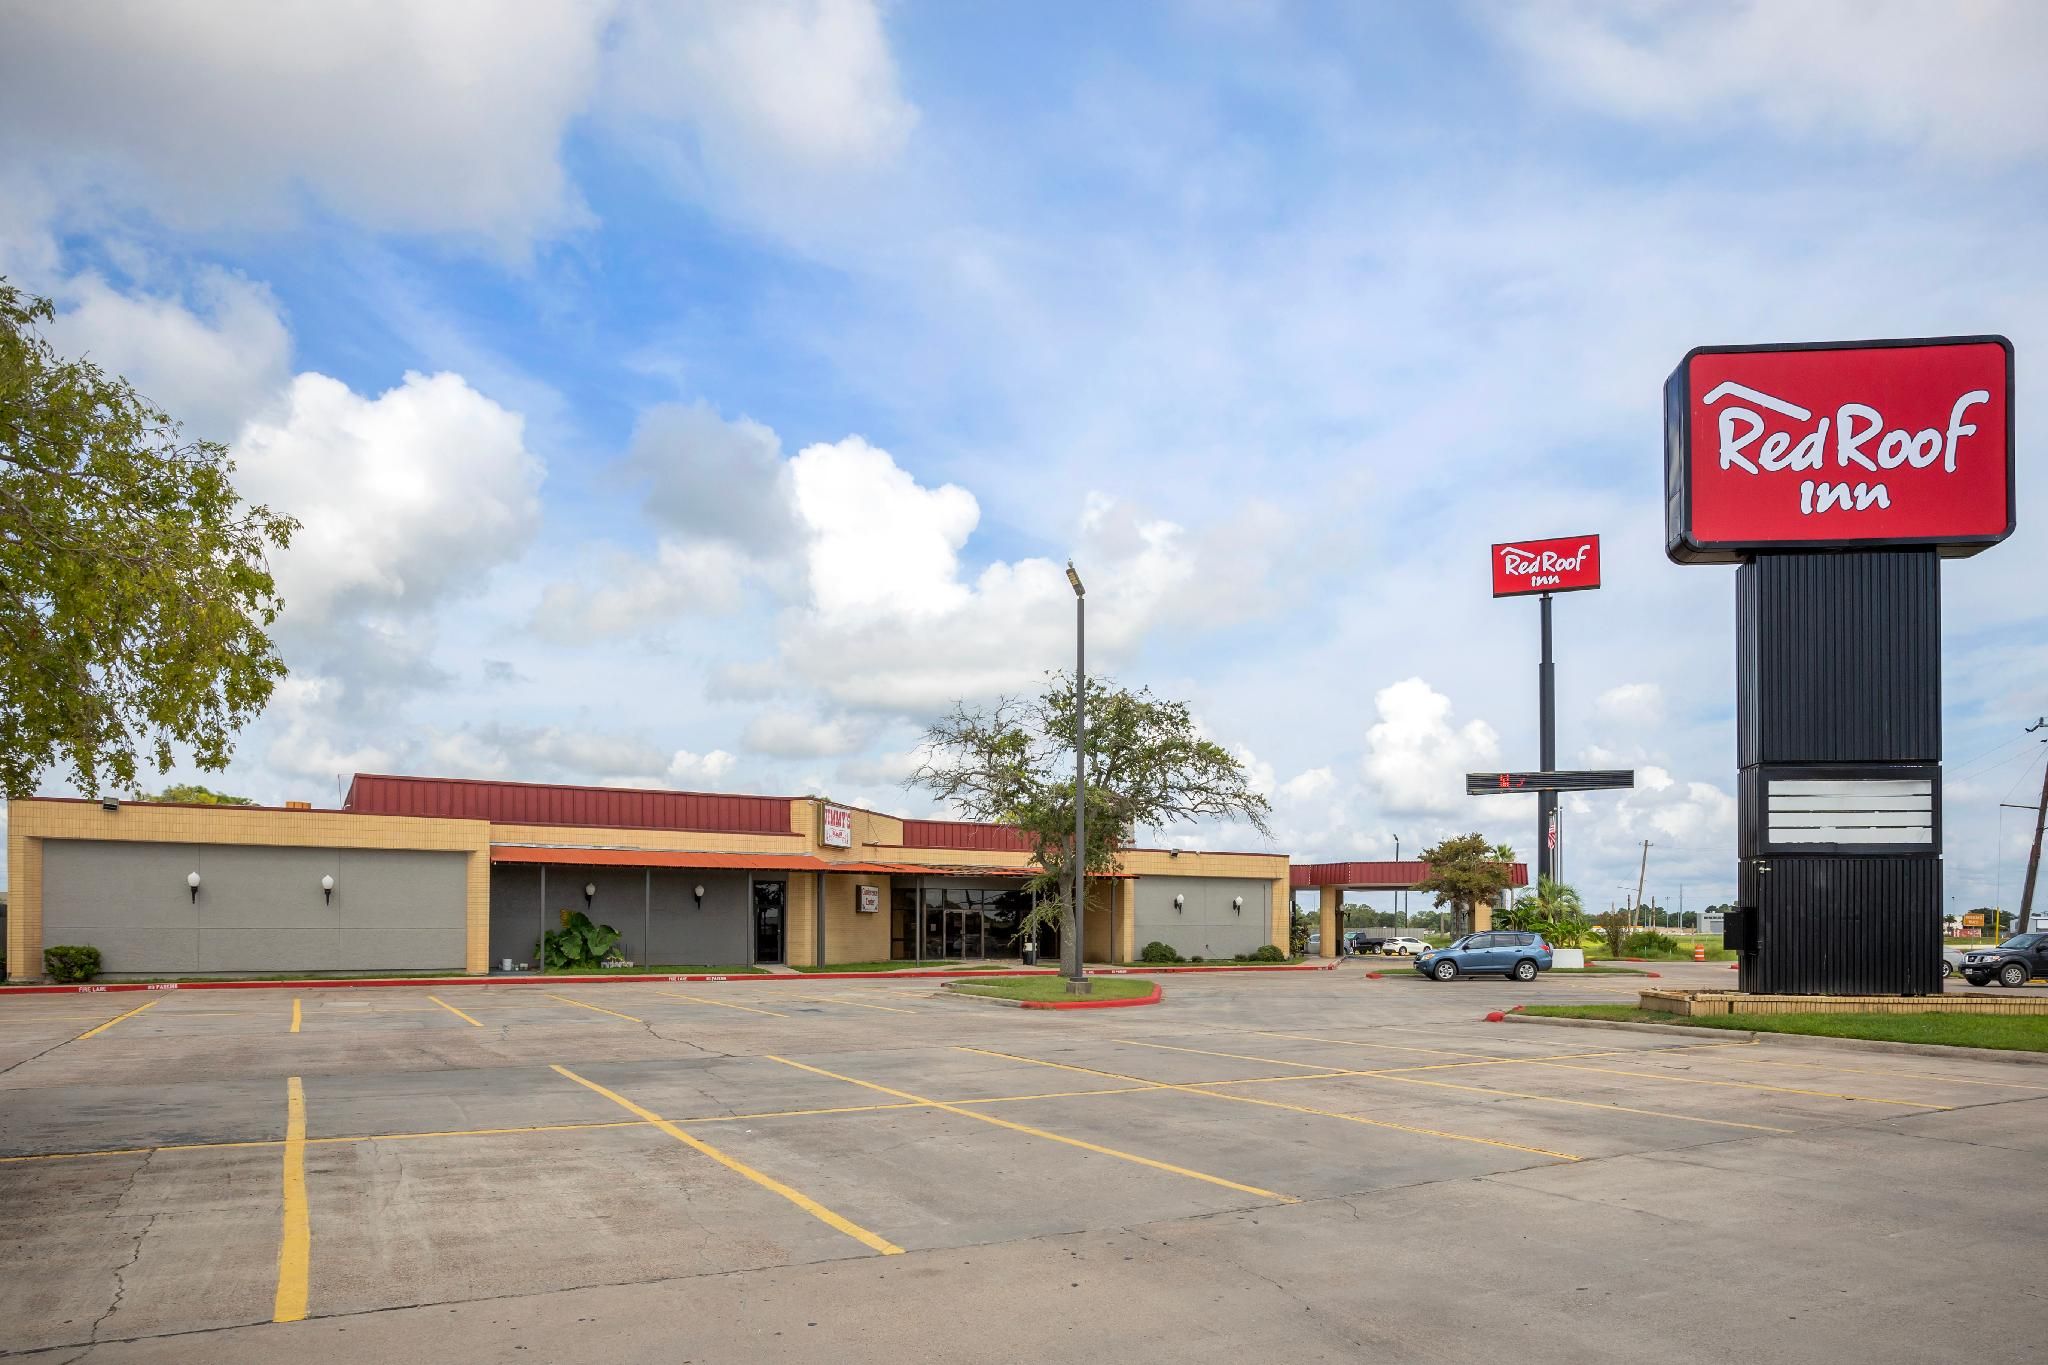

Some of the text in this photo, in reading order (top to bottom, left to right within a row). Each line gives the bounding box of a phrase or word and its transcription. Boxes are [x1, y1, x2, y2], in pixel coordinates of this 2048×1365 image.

[1718, 389, 1991, 475] Red Roof
[1505, 544, 1591, 576] Red Roof
